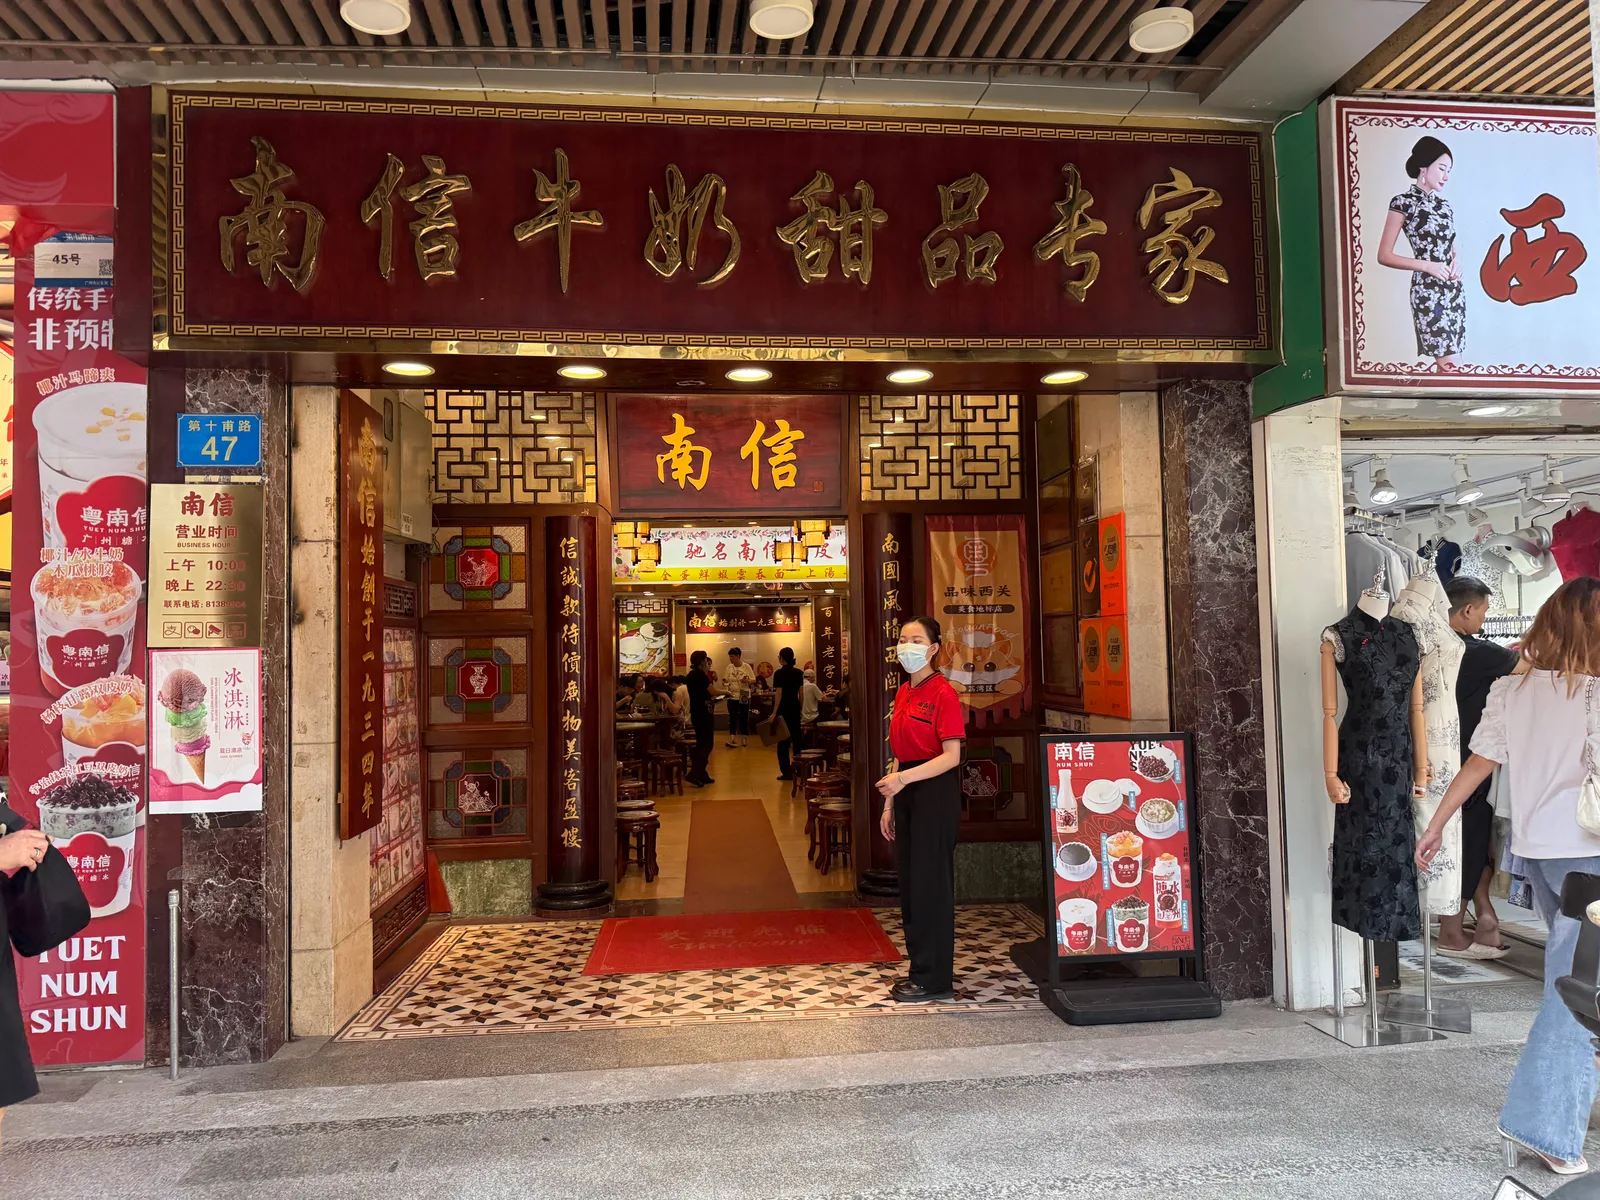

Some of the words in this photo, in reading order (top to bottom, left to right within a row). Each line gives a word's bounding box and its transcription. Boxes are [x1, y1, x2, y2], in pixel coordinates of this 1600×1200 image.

[219, 136, 1230, 304] 南信牛奶甜品专家
[1480, 193, 1588, 306] 西
[52, 253, 81, 266] 45号
[27, 287, 114, 311] 传统手
[36, 367, 116, 396] 椰汁马蹄爽
[188, 420, 252, 432] 第十甫路
[201, 436, 239, 461] 47
[656, 412, 806, 492] 南信
[181, 491, 236, 517] 南信
[83, 525, 105, 533] YUET
[176, 524, 239, 539] 营业时间
[40, 547, 124, 563] 椰汁/水牛奶
[52, 563, 114, 578] 木瓜桃胶
[166, 559, 196, 571] 上午
[207, 560, 247, 571] 10:00
[165, 579, 195, 592] 晚上
[206, 580, 247, 591] 22:30
[943, 585, 1012, 597] 品味西关
[958, 605, 1003, 613] 美食地标店
[61, 644, 110, 657] 粤南信
[40, 682, 133, 725] 杨枝甘露双皮奶
[224, 667, 245, 730] 冰淇淋
[1054, 742, 1095, 761] 南信
[40, 970, 118, 998] NUM
[30, 1004, 127, 1034] SHUN
